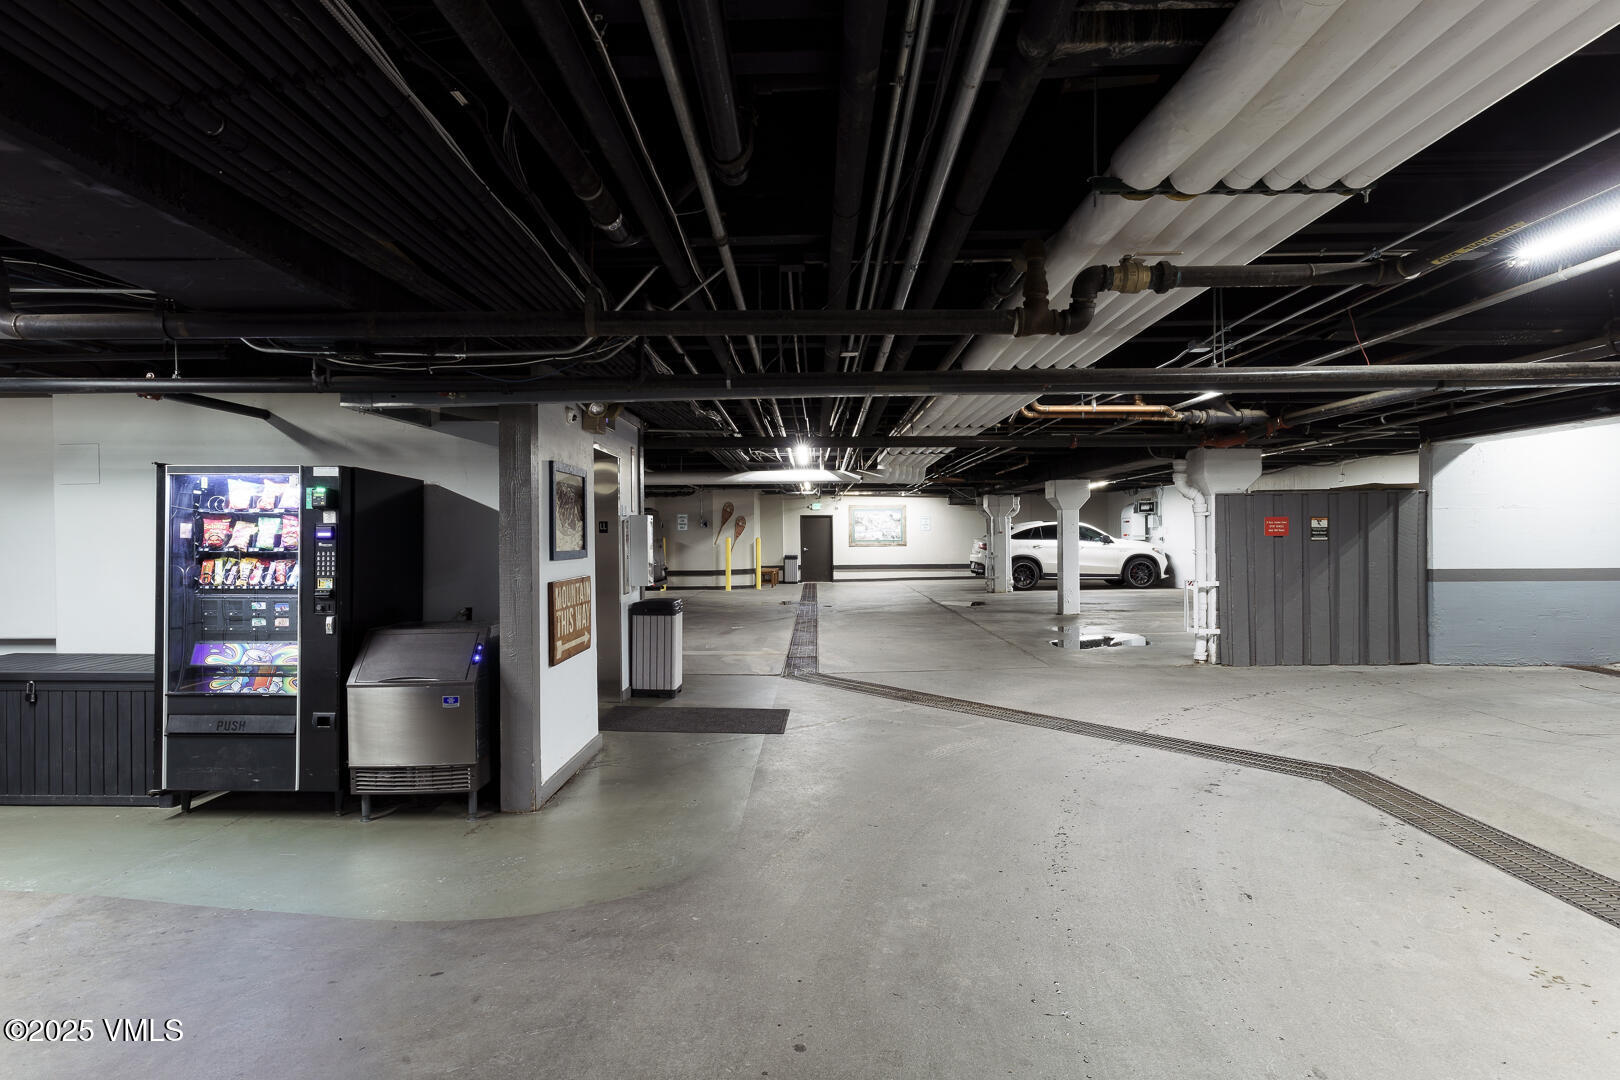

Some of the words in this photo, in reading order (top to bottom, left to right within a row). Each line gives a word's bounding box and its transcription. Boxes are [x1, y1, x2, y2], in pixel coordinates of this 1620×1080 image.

[556, 581, 590, 610] MOUNTAIN
[556, 607, 574, 638] THIS
[575, 602, 590, 630] WAY
[216, 720, 246, 731] PUSH
